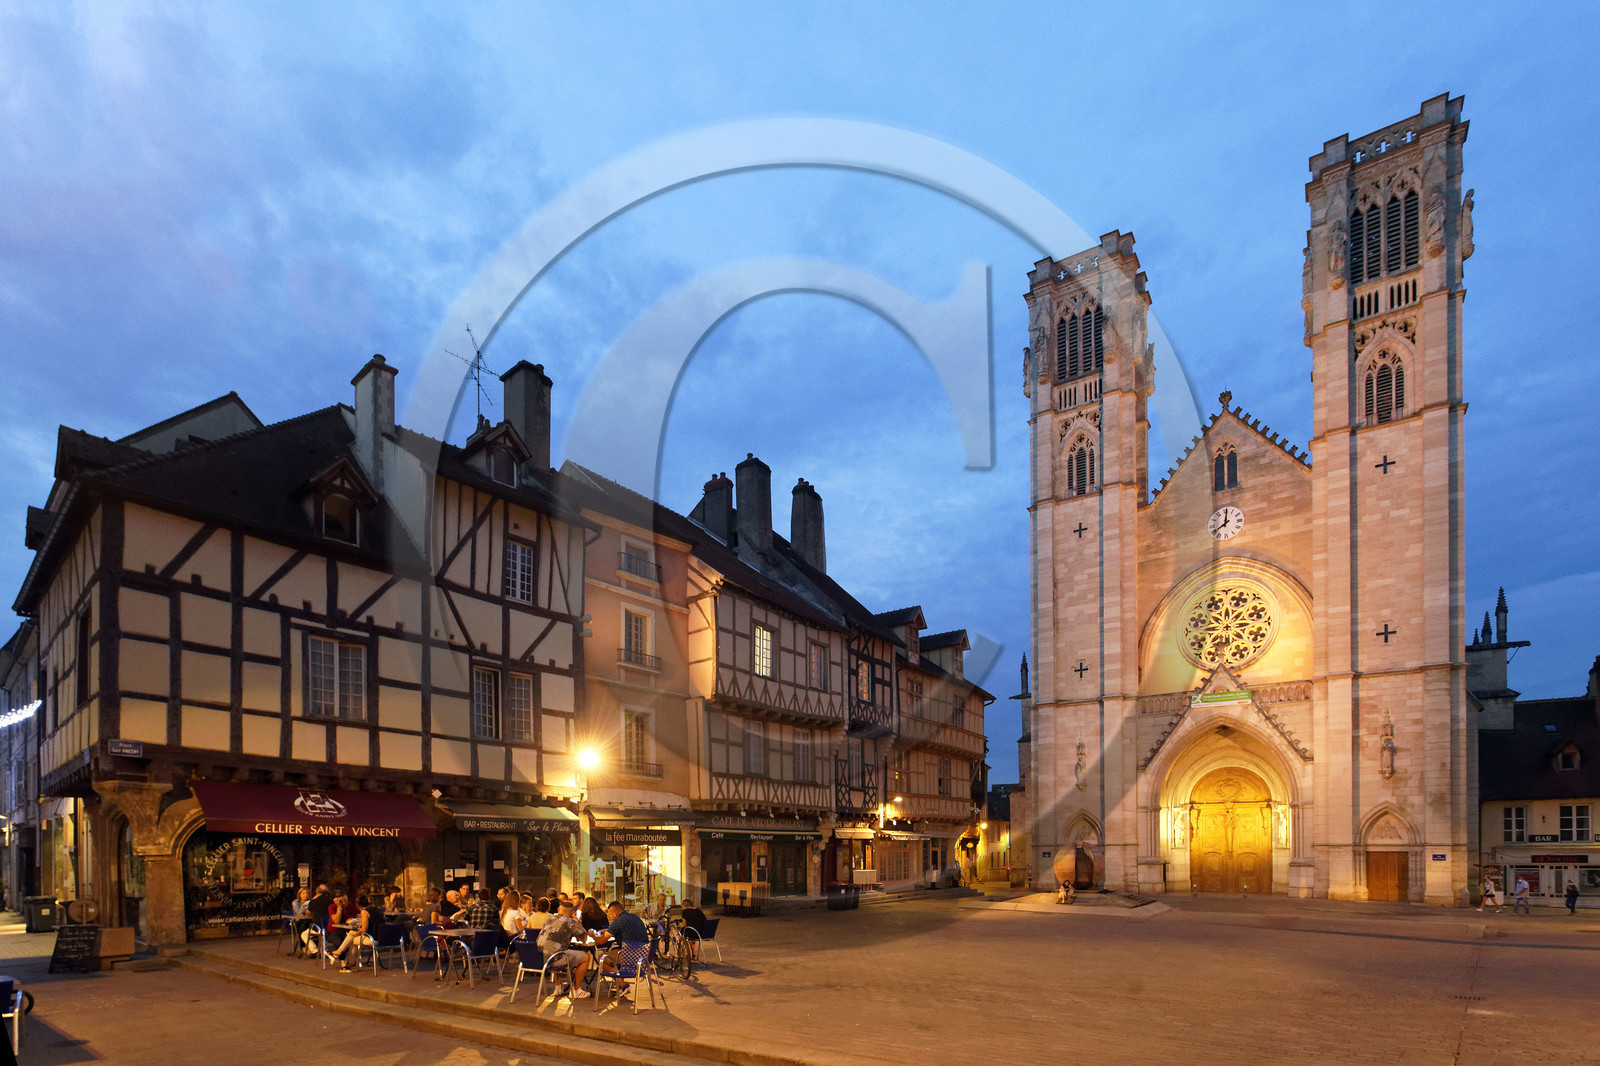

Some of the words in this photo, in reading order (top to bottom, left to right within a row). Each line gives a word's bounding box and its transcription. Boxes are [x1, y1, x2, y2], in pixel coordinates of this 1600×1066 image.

[255, 823, 303, 834] CELLIER
[310, 824, 345, 836] SAINT
[352, 827, 400, 838] VINCENT
[479, 821, 516, 829] RESTAURANT
[605, 833, 612, 841] la
[613, 831, 625, 845] fée
